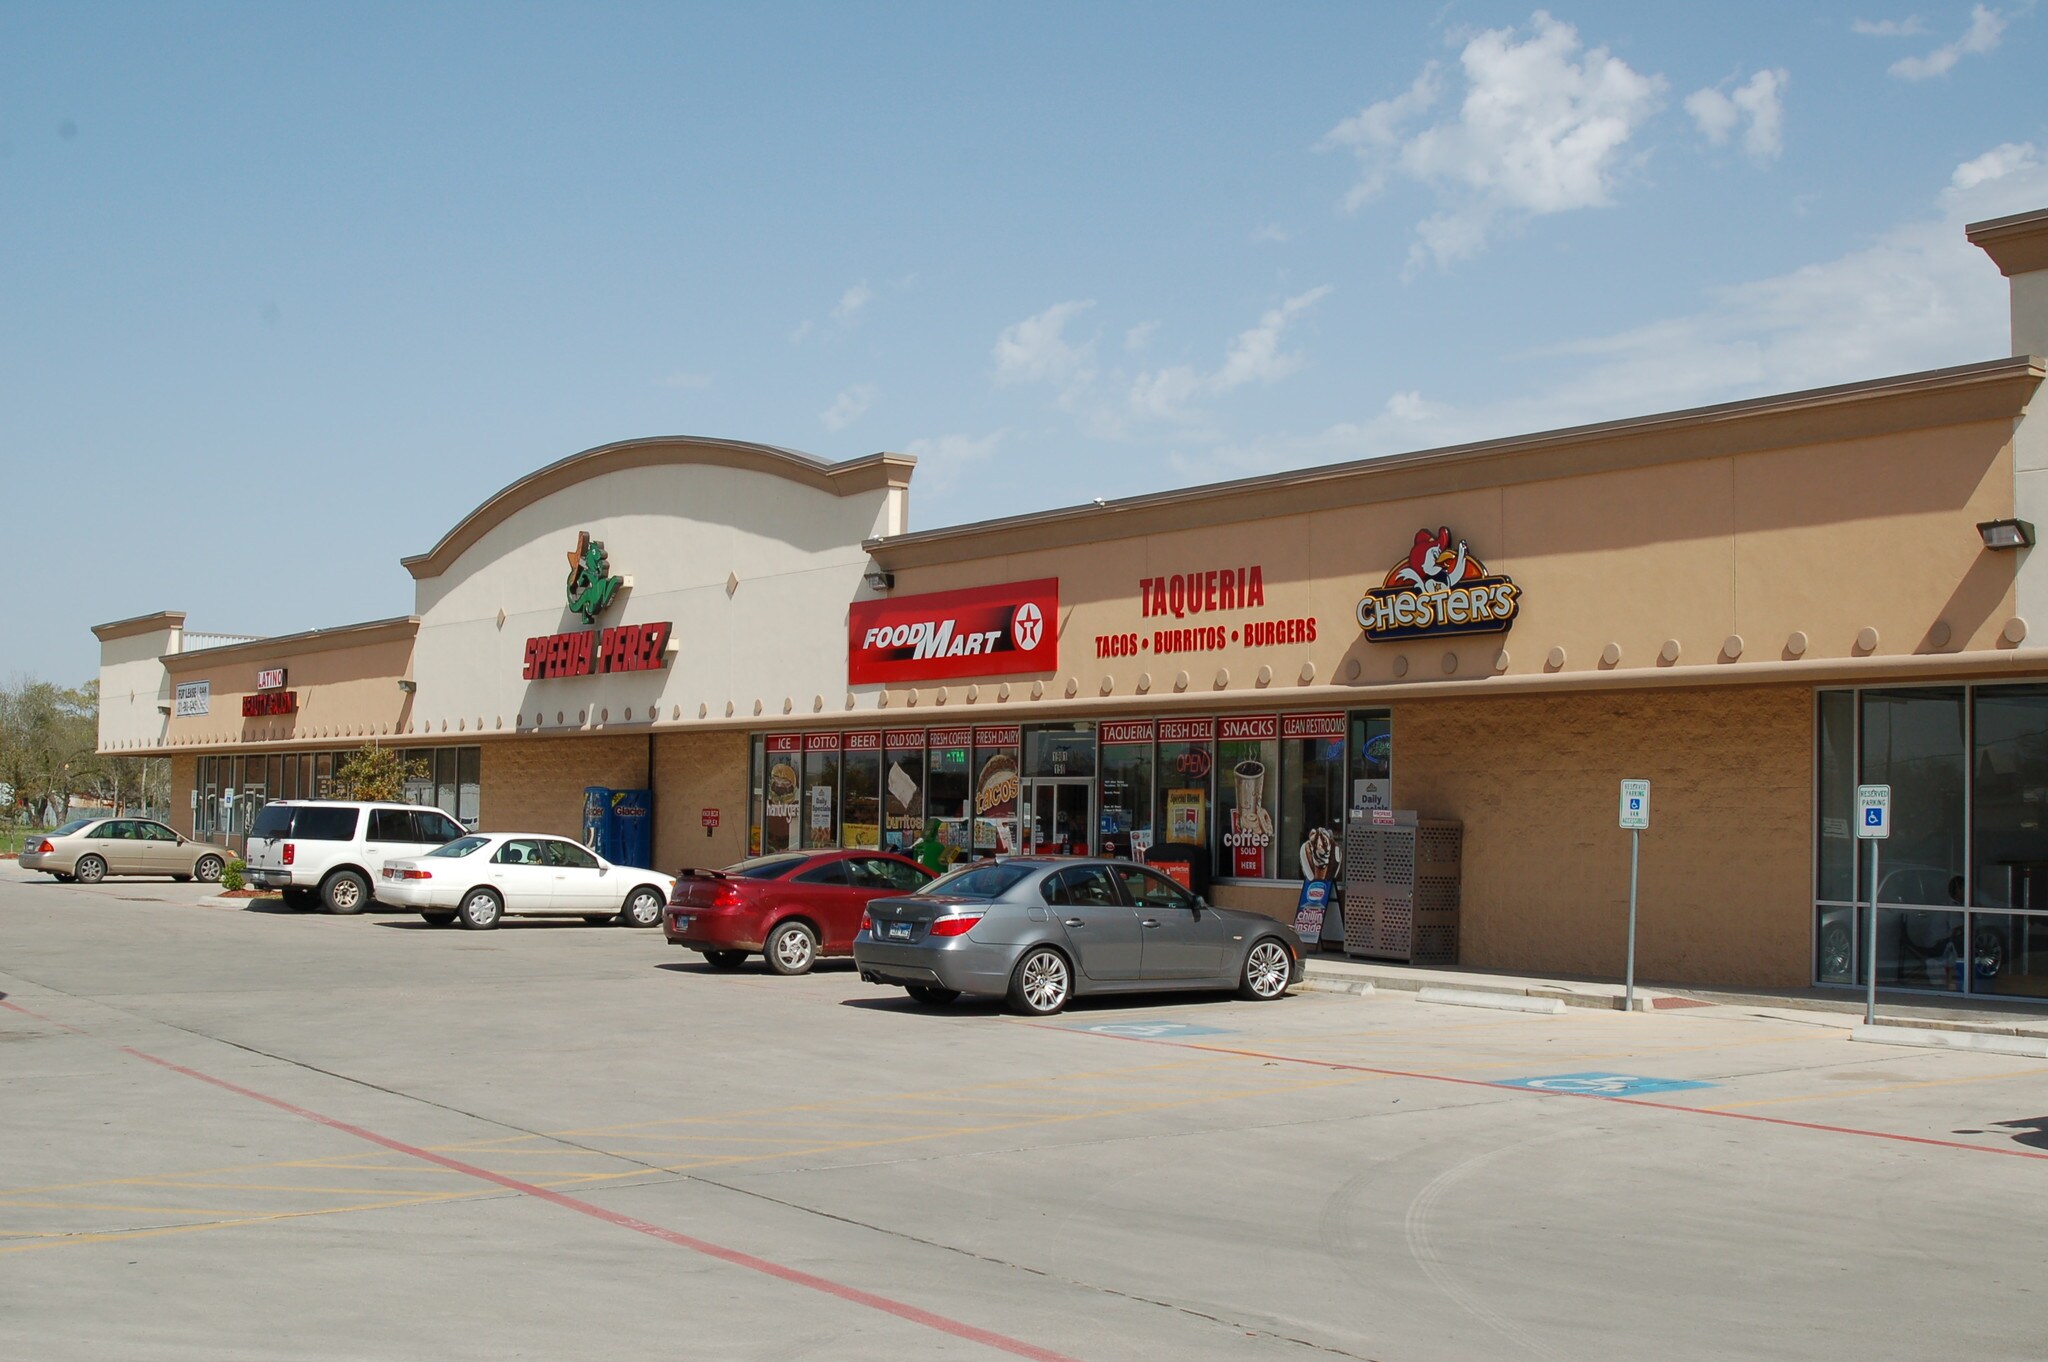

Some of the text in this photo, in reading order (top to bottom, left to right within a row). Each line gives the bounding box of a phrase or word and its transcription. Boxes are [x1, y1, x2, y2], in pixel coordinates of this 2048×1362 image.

[1139, 565, 1264, 619] TAQUERIA
[1095, 617, 1317, 658] TACOS BURRITOS BURGERS
[523, 621, 670, 680] SPEEDY PEREZ
[258, 670, 282, 687] LATINO
[1103, 725, 1153, 740] TAQUERIA
[1160, 722, 1213, 738] FRESH DELI
[1223, 720, 1274, 737] SNACKS
[1284, 717, 1345, 734] CLEAN RESTROOMS
[778, 738, 791, 749] ICE
[808, 736, 837, 749] LOTTO
[851, 735, 876, 748] BEER
[886, 733, 925, 746] COLD SODA
[930, 731, 971, 745] FRESH COFFEE
[976, 730, 1019, 744] FRESH DAIRY
[1176, 754, 1206, 773] OPEN
[975, 775, 1019, 815] tacos
[1362, 795, 1382, 804] Daily
[615, 806, 646, 816] Glacier
[767, 800, 799, 823] hamburgers
[886, 812, 924, 830] burritos
[1223, 828, 1269, 847] coffee
[1240, 847, 1257, 855] SOLD
[1240, 861, 1256, 870] HERE
